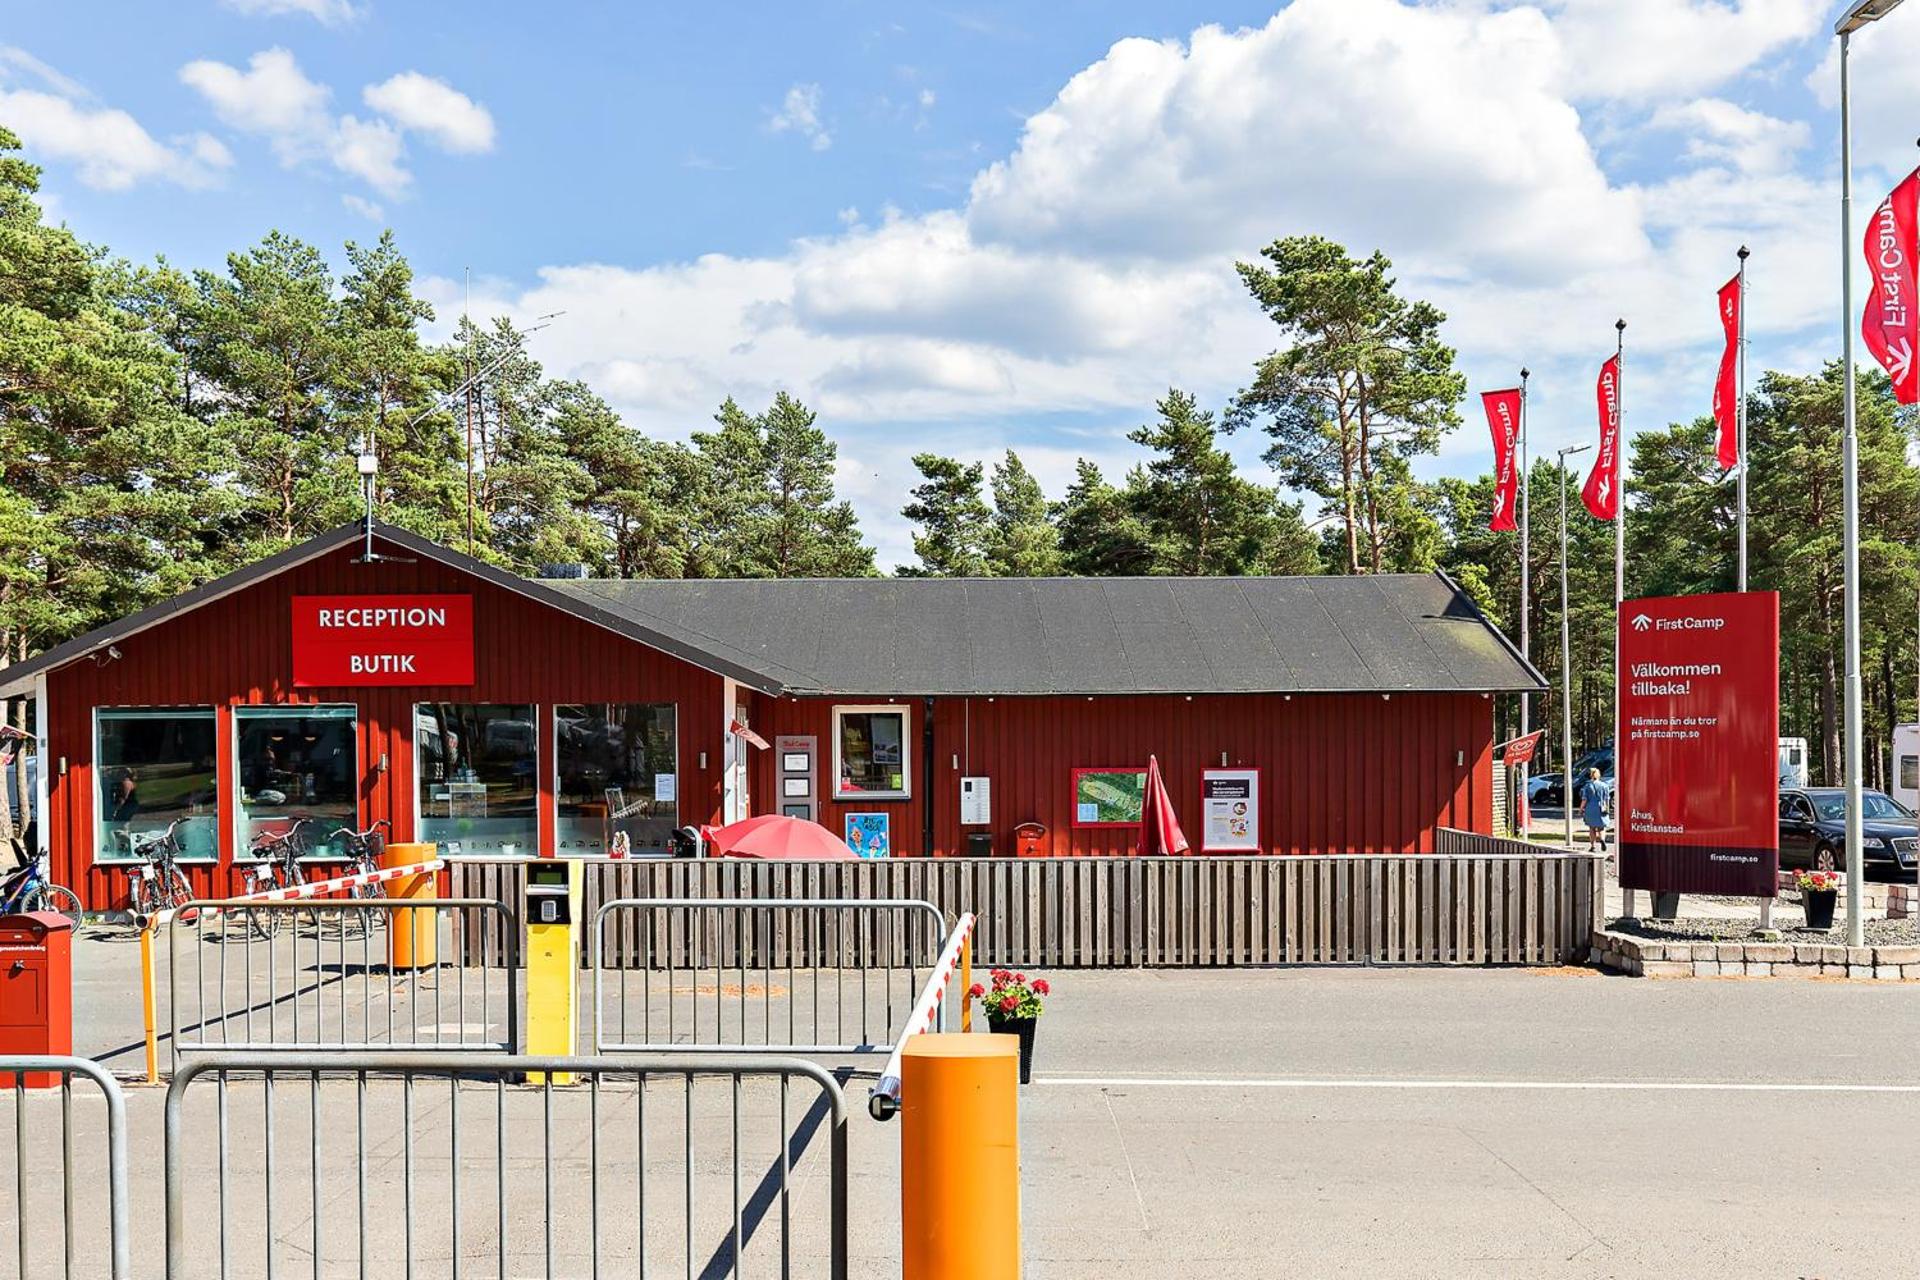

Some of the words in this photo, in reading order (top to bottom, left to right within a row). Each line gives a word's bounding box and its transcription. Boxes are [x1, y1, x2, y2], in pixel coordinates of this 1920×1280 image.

[319, 608, 446, 627] RECEPTION
[351, 655, 416, 673] BUTIK
[1631, 663, 1722, 678] Välkommen
[1631, 680, 1691, 696] tillbaka!
[1683, 716, 1696, 726] du
[1697, 716, 1717, 726] tror
[1631, 729, 1642, 740] på
[1643, 729, 1700, 740] firstcamp.se
[1630, 808, 1654, 821] Åhus,
[1631, 823, 1684, 834] Kristianstad
[1710, 854, 1759, 864] firstcamp.se
